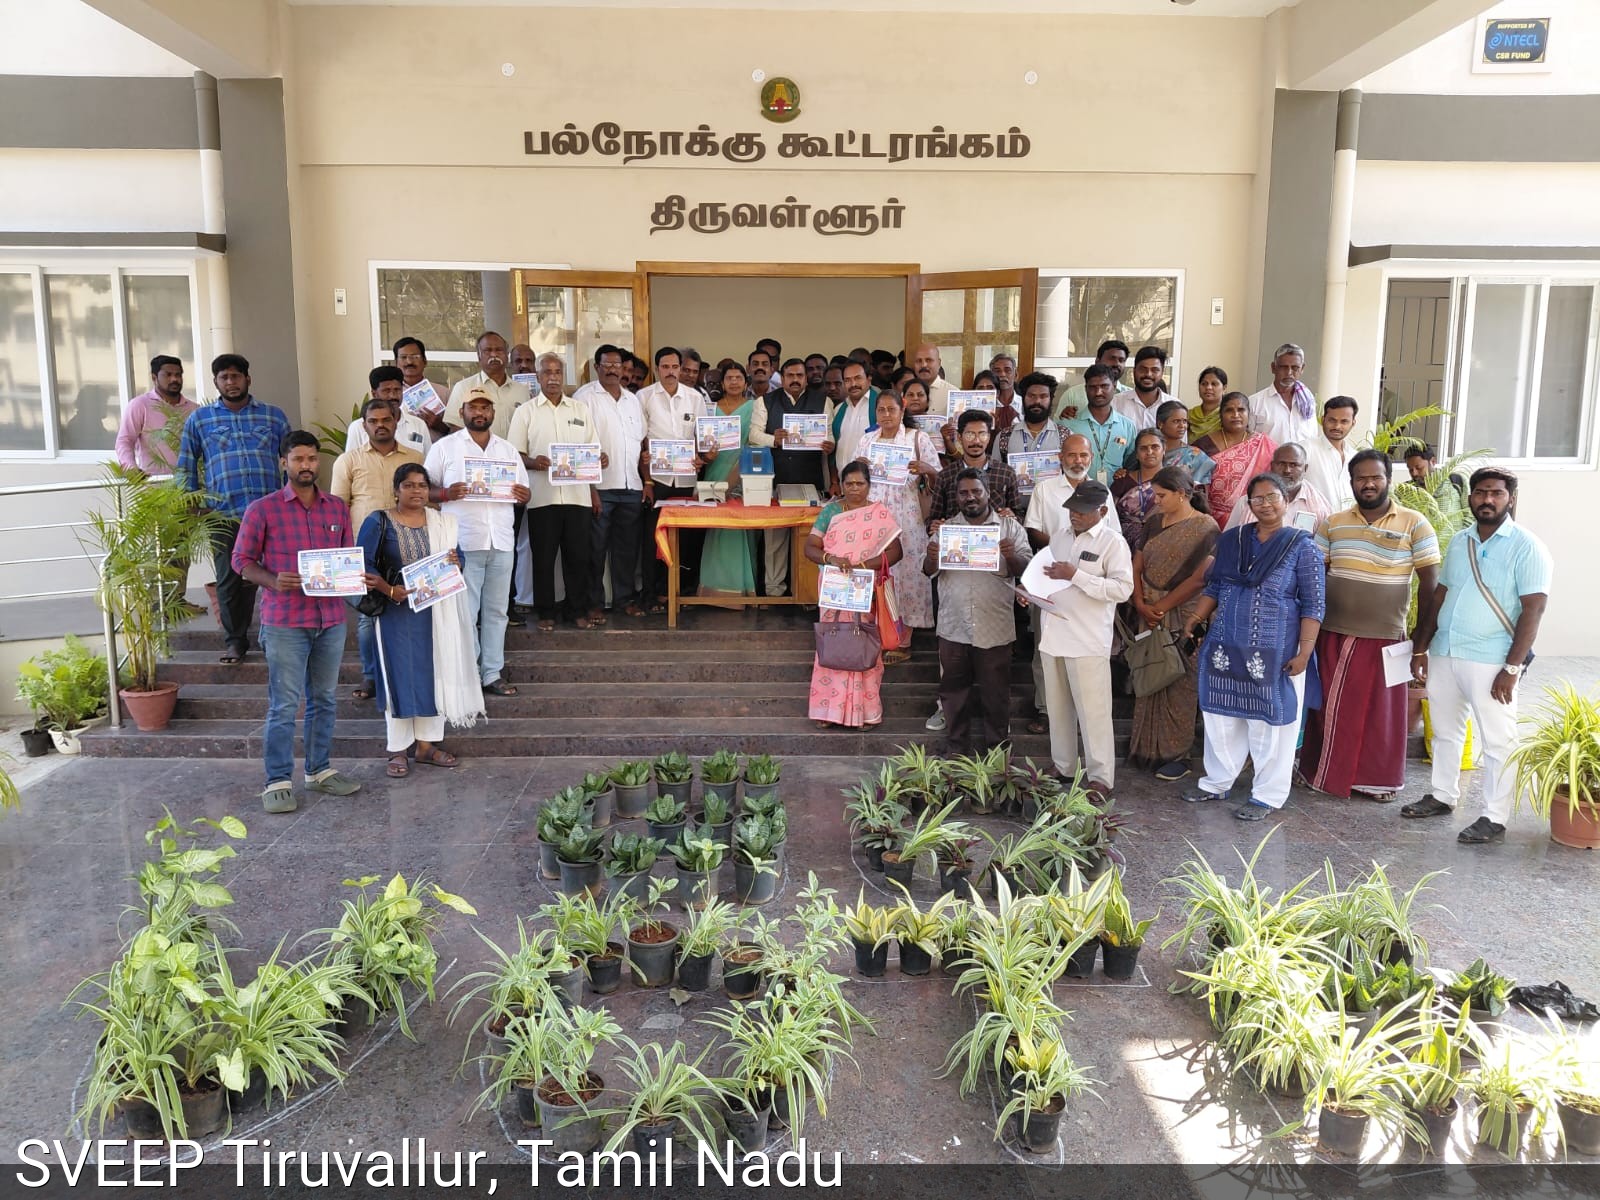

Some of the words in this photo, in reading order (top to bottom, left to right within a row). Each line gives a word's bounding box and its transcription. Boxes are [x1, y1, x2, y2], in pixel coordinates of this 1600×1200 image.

[1504, 34, 1539, 47] NTECL
[1495, 52, 1509, 60] CSR
[1511, 52, 1531, 60] FUND
[524, 122, 766, 165] பல்நோக்கு
[777, 125, 1031, 163] கூட்டரங்கம்
[650, 194, 906, 236] திருவள்ளூர்
